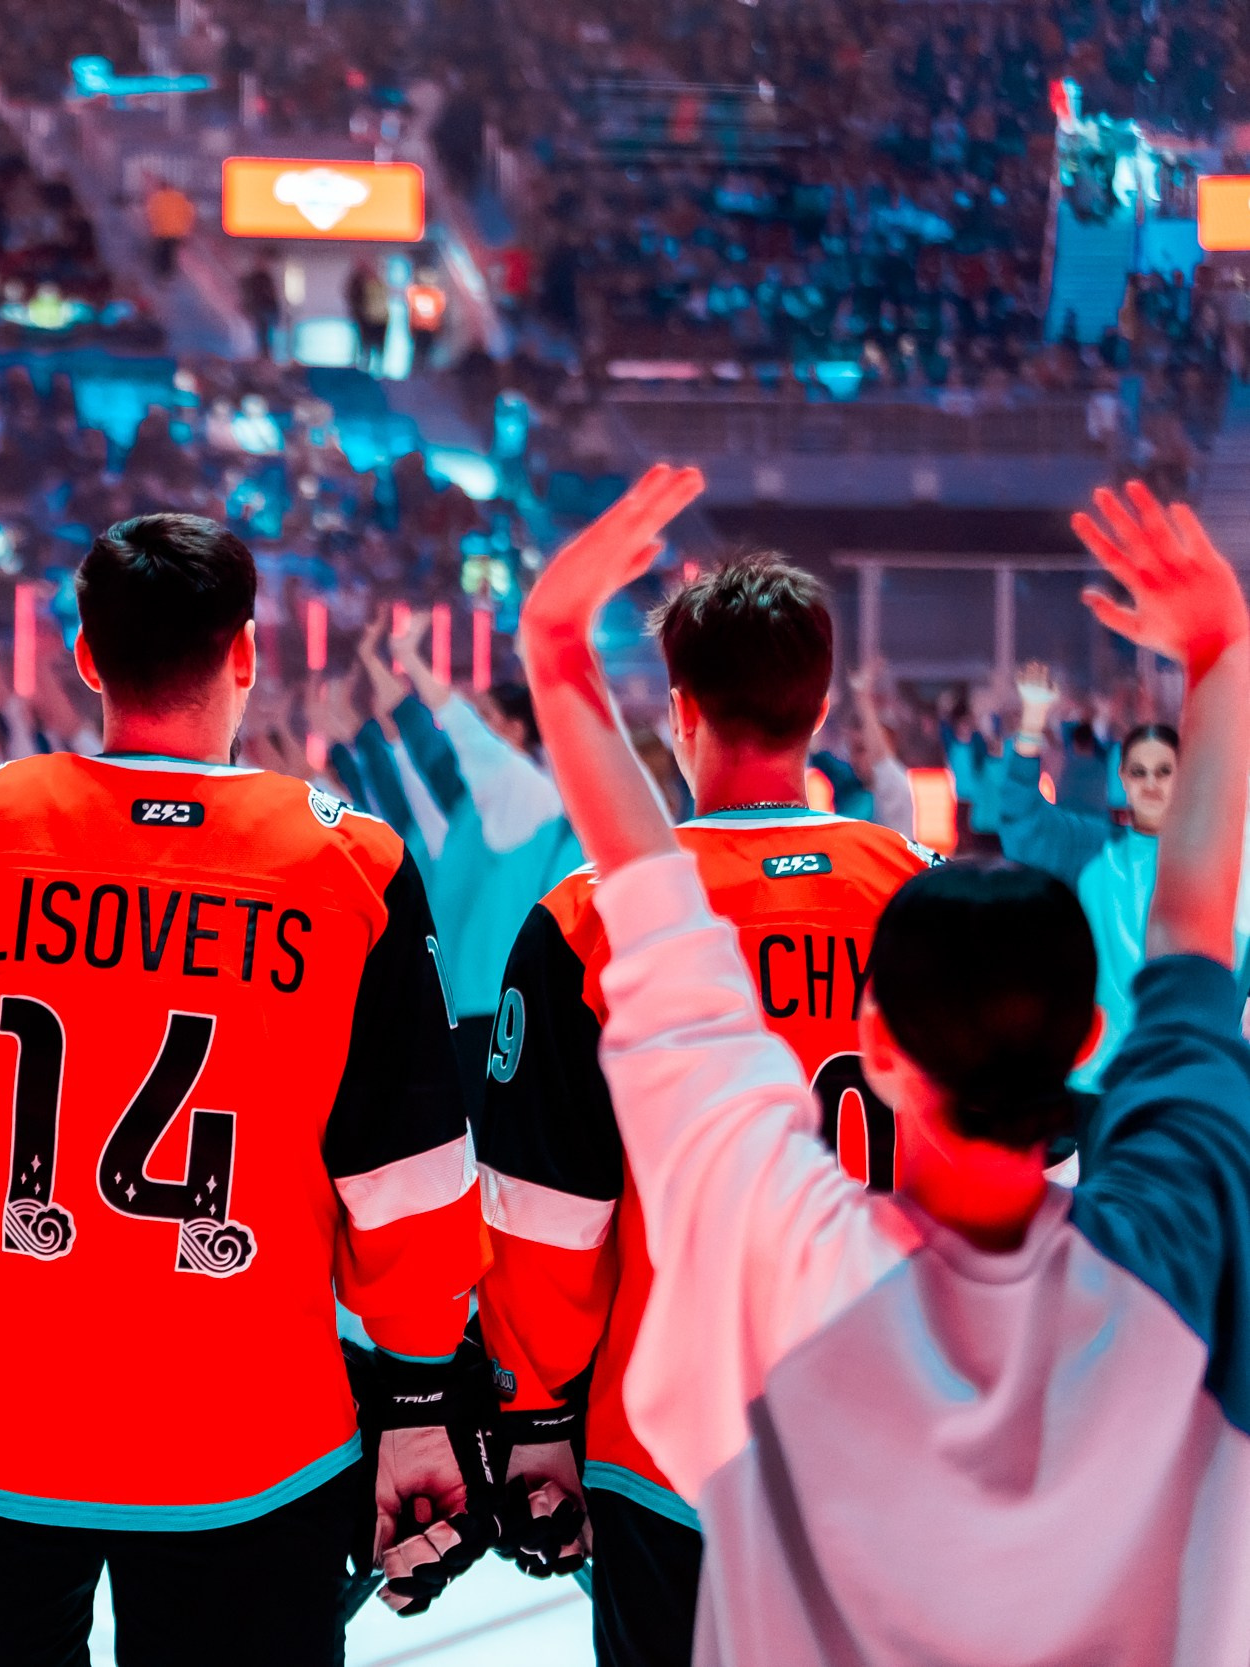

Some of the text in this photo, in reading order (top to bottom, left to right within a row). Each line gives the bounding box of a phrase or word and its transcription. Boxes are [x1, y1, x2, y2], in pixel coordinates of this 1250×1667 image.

[425, 934, 459, 1030] 1
[759, 934, 872, 1021] CHY
[490, 986, 526, 1084] 9
[392, 1391, 444, 1404] TRUE
[532, 1414, 576, 1427] TRUE
[476, 1428, 494, 1485] TRUE
